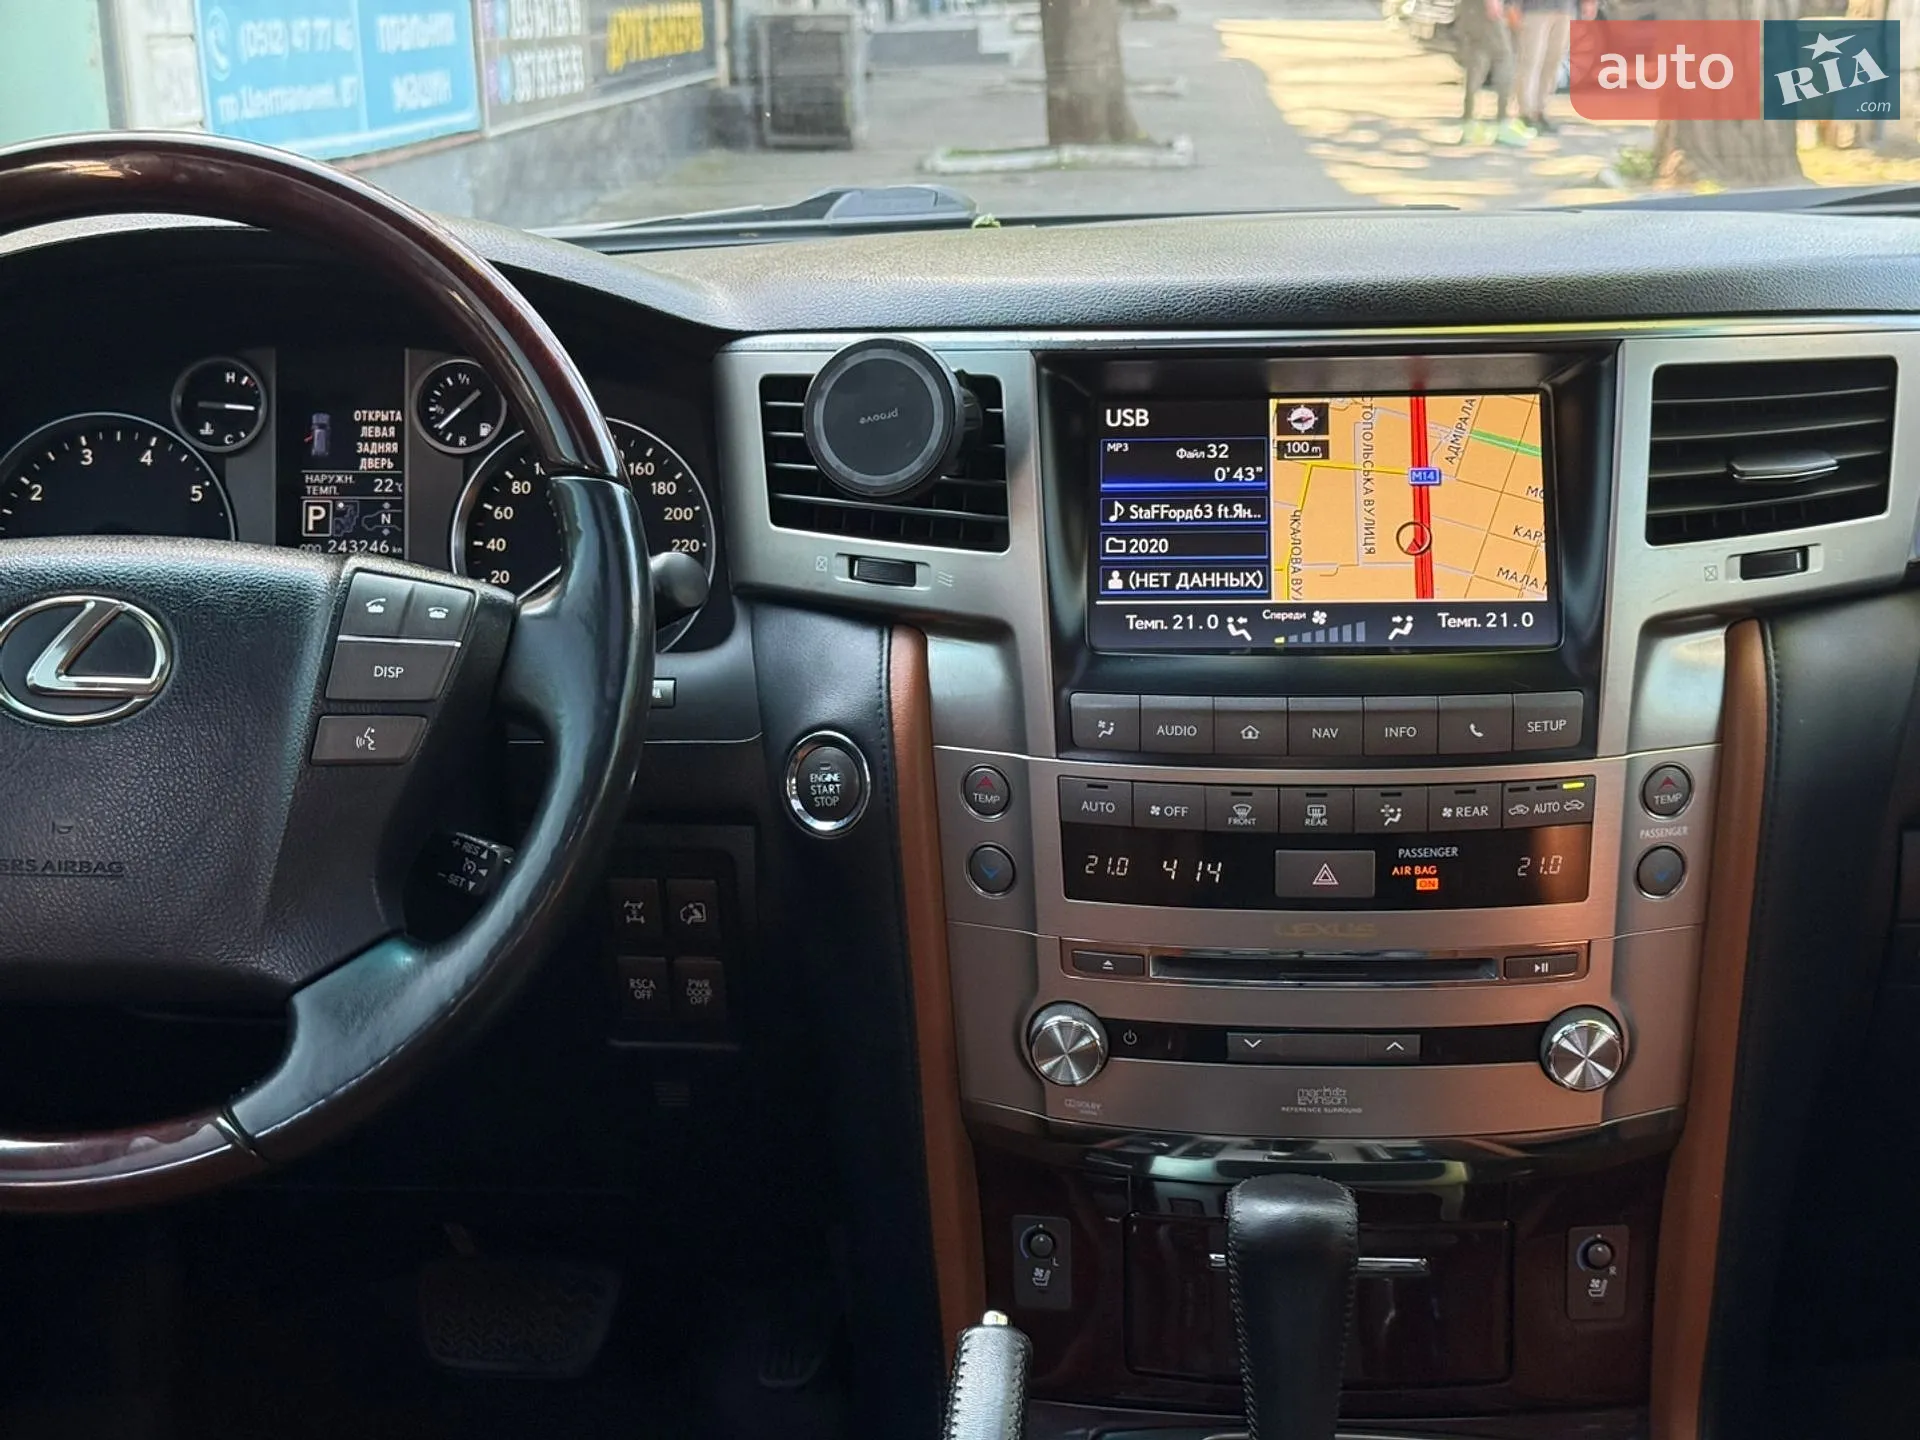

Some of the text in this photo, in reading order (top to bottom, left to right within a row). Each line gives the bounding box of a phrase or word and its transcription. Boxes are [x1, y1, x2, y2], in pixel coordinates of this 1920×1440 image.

[225, 371, 236, 383] H
[353, 410, 402, 422] ОТКРЫТА
[859, 407, 899, 425] proove
[1105, 408, 1150, 428] USB
[360, 426, 396, 438] ЛЕВАЯ
[1445, 398, 1476, 466] АДМІРАЛА
[224, 434, 234, 445] C
[458, 436, 467, 447] R
[356, 442, 399, 455] ЗАДНЯЯ
[1106, 442, 1129, 452] MP3
[1176, 443, 1229, 460] Файл 32
[1285, 441, 1310, 453] 100
[80, 449, 94, 466] 3
[140, 449, 154, 466] 4
[359, 457, 394, 470] ДВЕРЬ
[628, 461, 655, 476] 160
[305, 474, 355, 484] НАРУЖН.
[1411, 471, 1435, 481] M14
[306, 485, 340, 496] ТЕМП.
[373, 478, 394, 493] 22
[511, 481, 531, 495] 80
[651, 482, 676, 496] 180
[30, 484, 43, 502] 2
[190, 484, 203, 502] 5
[307, 505, 327, 532] P
[381, 514, 391, 525] N
[493, 506, 514, 520] 60
[664, 507, 693, 521] 200
[1363, 499, 1376, 555] ВУЛИЦЯ
[327, 539, 390, 553] 243246
[486, 538, 506, 551] 40
[671, 538, 699, 552] 220
[1129, 538, 1169, 553] 2020
[1290, 509, 1303, 574] ЧКАЛОВА
[490, 570, 510, 584] 20
[1129, 570, 1263, 590] (НЕТ ДАННЫХ)
[1496, 566, 1539, 589] МАЛА
[1262, 609, 1307, 622] Спереди
[1438, 612, 1482, 629] Темп.
[1125, 614, 1168, 631] Темп.
[373, 666, 404, 679] DISP
[1156, 725, 1198, 737] AUDIO
[1384, 726, 1417, 738] INFO
[1527, 719, 1567, 733] SETUP
[1312, 727, 1339, 739] NAV
[810, 773, 841, 783] ENGINE
[810, 784, 842, 795] START
[814, 796, 840, 807] STOP
[973, 792, 1001, 804] TEMP
[1653, 793, 1682, 805] TEMP
[1081, 800, 1116, 814] AUTO
[1164, 806, 1189, 817] OFF
[1455, 806, 1489, 818] REAR
[1533, 802, 1560, 814] AUTO
[1228, 817, 1257, 826] FRONT
[1305, 817, 1328, 826] REAR
[1640, 826, 1689, 839] PASSENGER
[1398, 846, 1459, 859] PASSENGER
[41, 859, 124, 873] AIRBAG
[1085, 854, 1130, 876] 21.0
[1392, 865, 1437, 876] AIR BAG
[1517, 855, 1562, 877] 21.0
[1419, 880, 1437, 890] ON
[1275, 923, 1377, 938] LEXUS
[629, 978, 656, 989] RSCA
